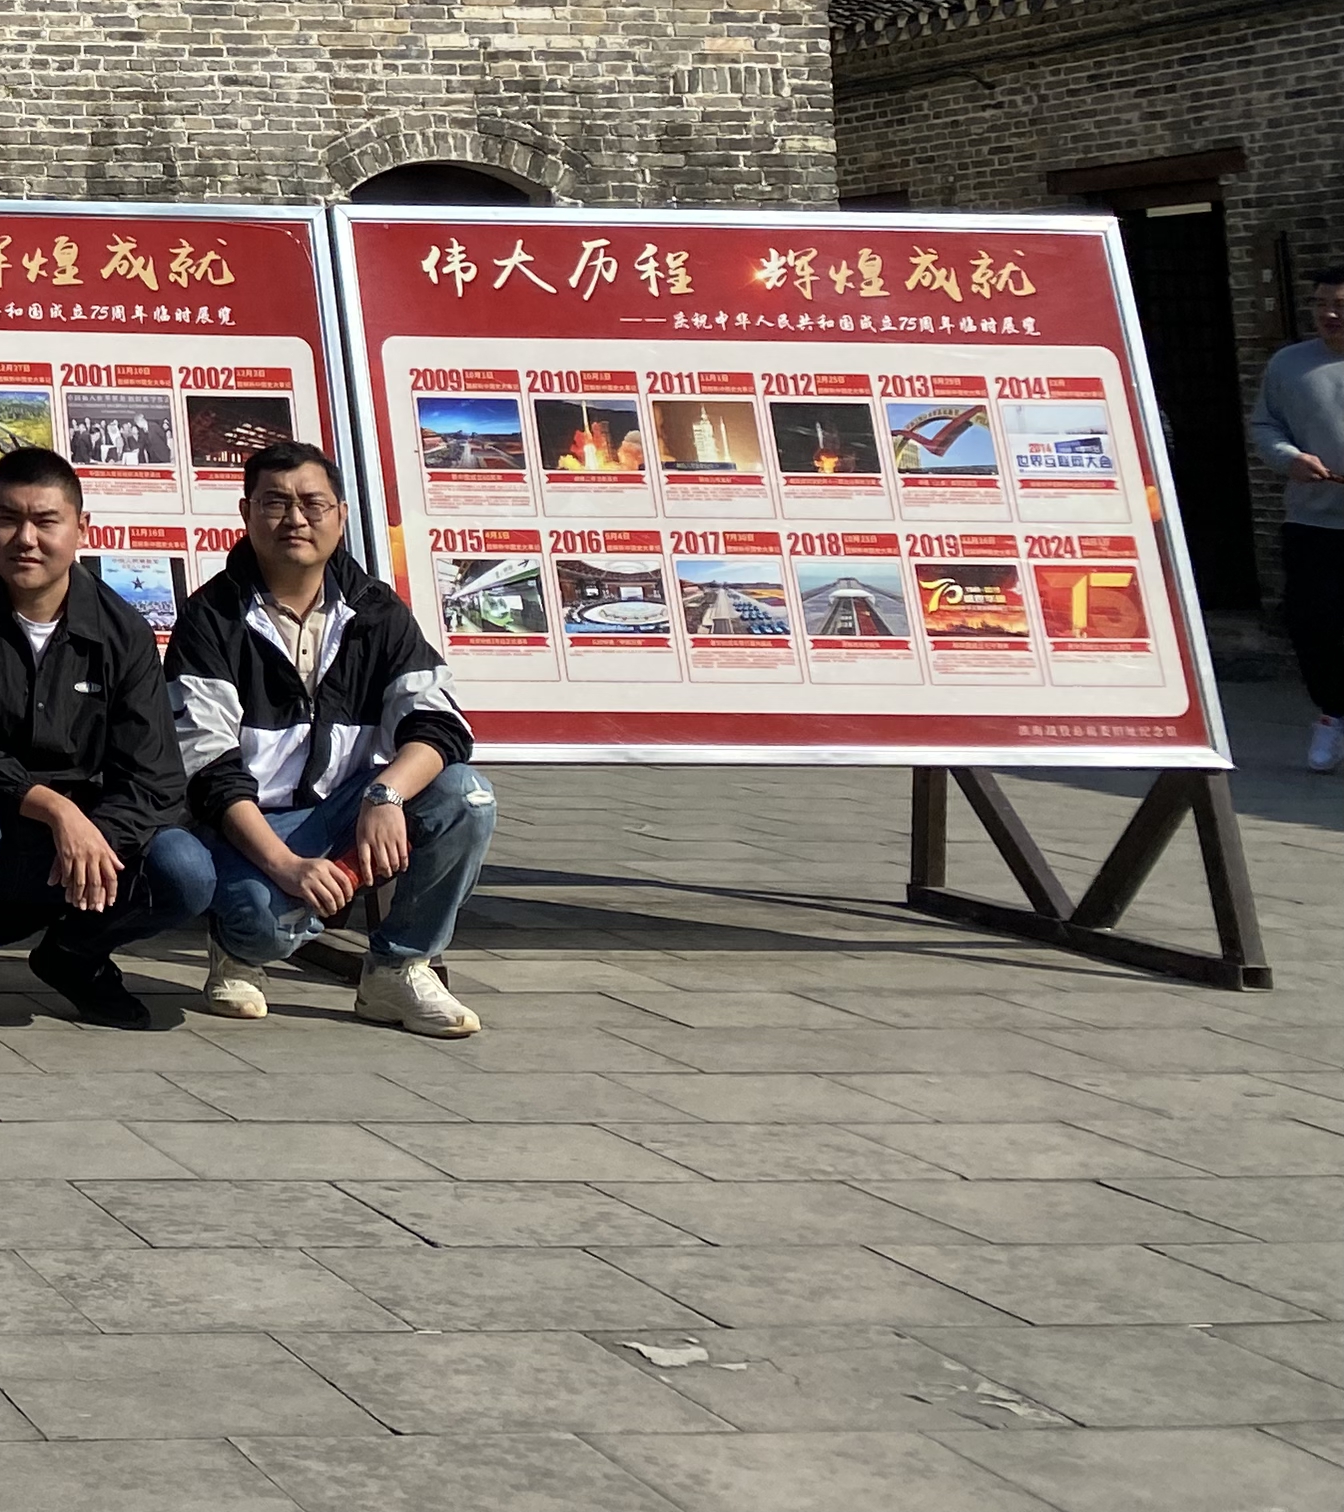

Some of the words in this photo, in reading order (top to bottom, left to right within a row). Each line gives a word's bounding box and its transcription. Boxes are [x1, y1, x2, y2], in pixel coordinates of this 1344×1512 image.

[421, 238, 695, 301] 伟大历程
[759, 245, 1036, 302] 辉煌成就
[60, 364, 113, 386] 2001
[179, 366, 235, 389] 2002
[409, 368, 462, 391] 2009
[526, 370, 580, 393] 2010
[646, 371, 696, 394] 2011
[762, 373, 813, 396] 2012
[878, 375, 932, 398] 2013
[995, 377, 1049, 399] 2014
[1016, 455, 1114, 470] 世界互联网大会
[86, 525, 126, 549] 007
[429, 528, 483, 552] 2015
[549, 530, 602, 553] 2016
[670, 531, 720, 554] 2017
[787, 532, 841, 556] 2018
[906, 534, 960, 558] 2019
[1025, 536, 1077, 559] 2024
